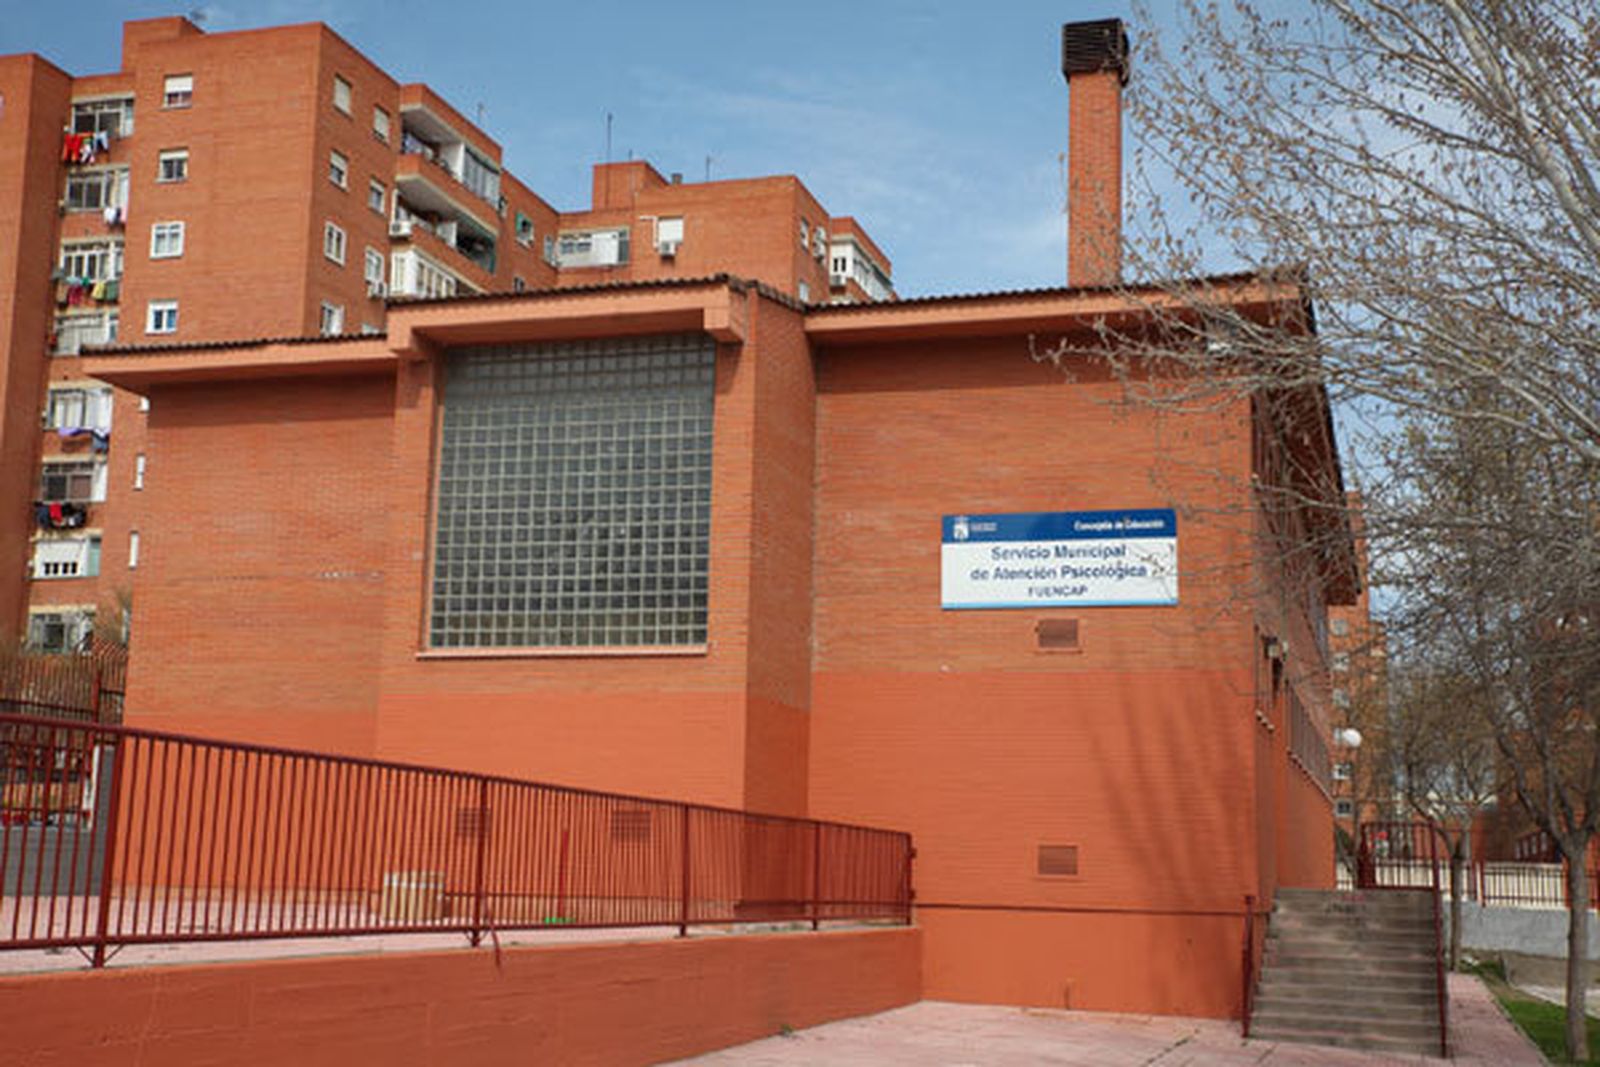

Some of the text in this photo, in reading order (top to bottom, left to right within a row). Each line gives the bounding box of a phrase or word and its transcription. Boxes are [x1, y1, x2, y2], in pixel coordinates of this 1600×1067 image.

[991, 544, 1126, 561] Servicio Municipal
[970, 563, 1147, 581] de Atención Psicológica
[1028, 585, 1088, 598] FUENCAP
